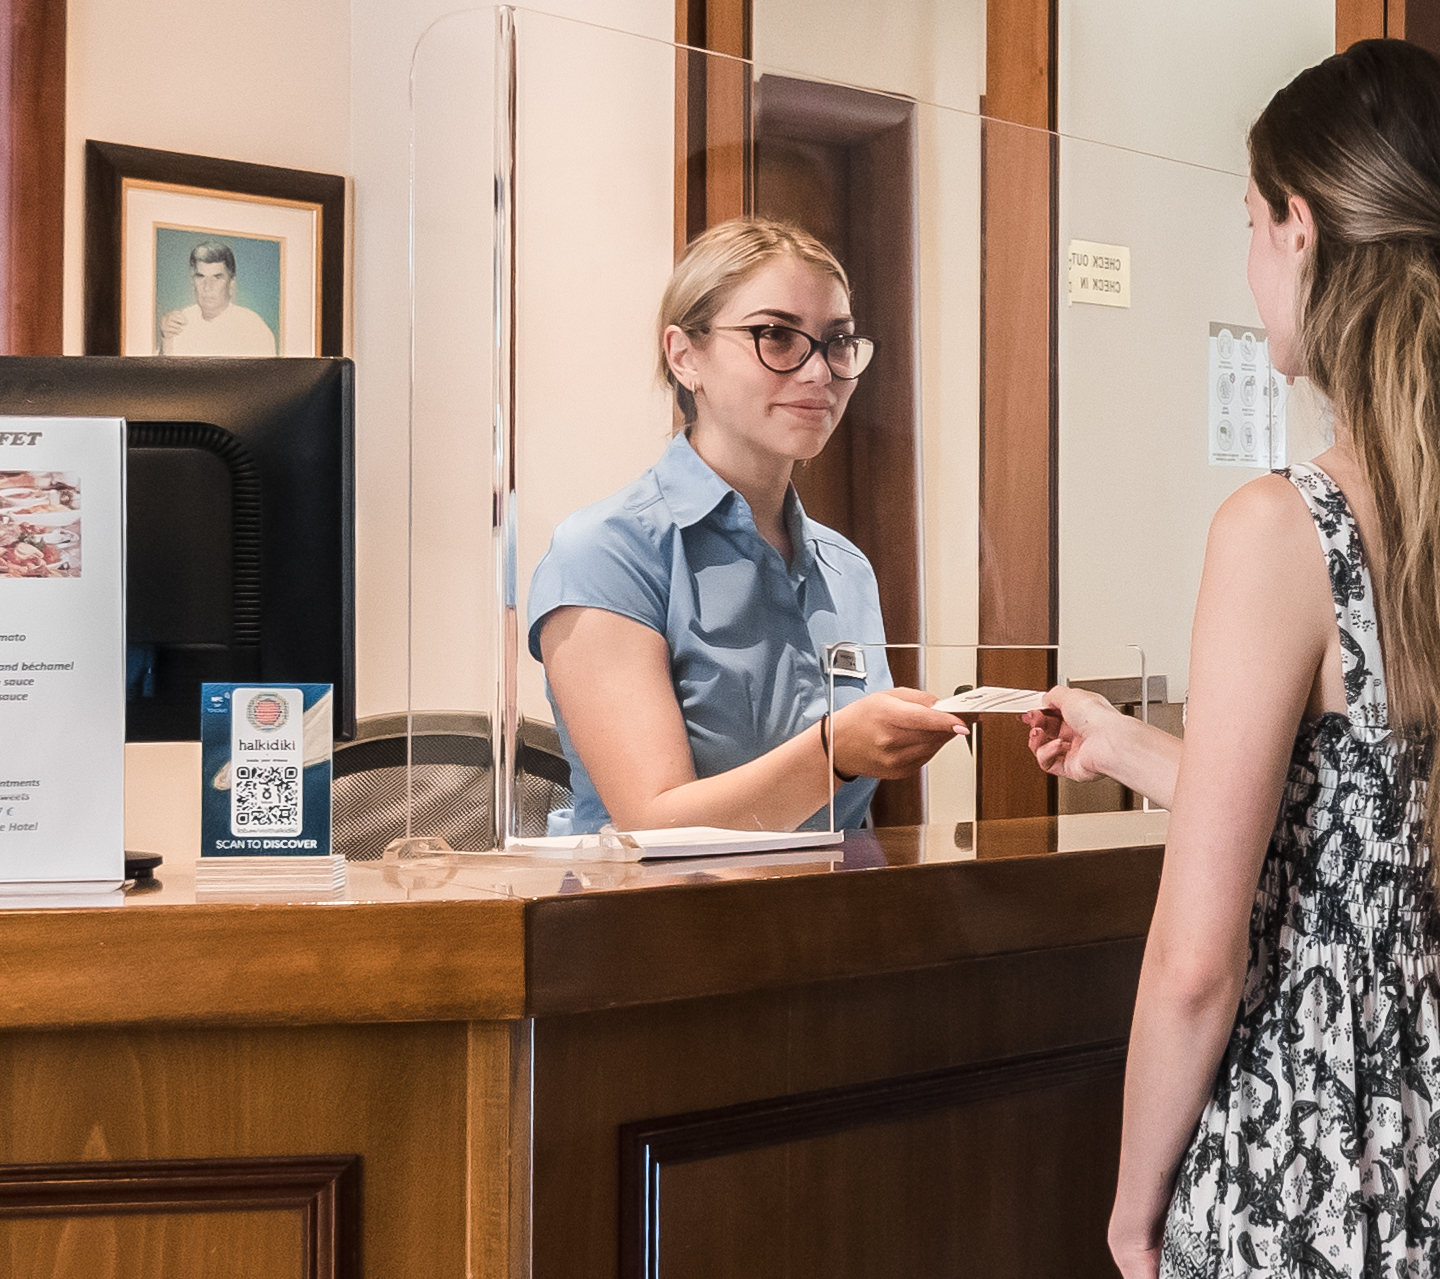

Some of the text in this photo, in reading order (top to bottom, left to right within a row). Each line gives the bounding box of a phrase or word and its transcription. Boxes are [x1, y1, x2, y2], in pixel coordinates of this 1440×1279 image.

[239, 739, 295, 751] halkidiki
[7, 807, 13, 816] €
[9, 822, 39, 831] Hotel
[216, 840, 317, 849] SCAN TO DISCOVER
